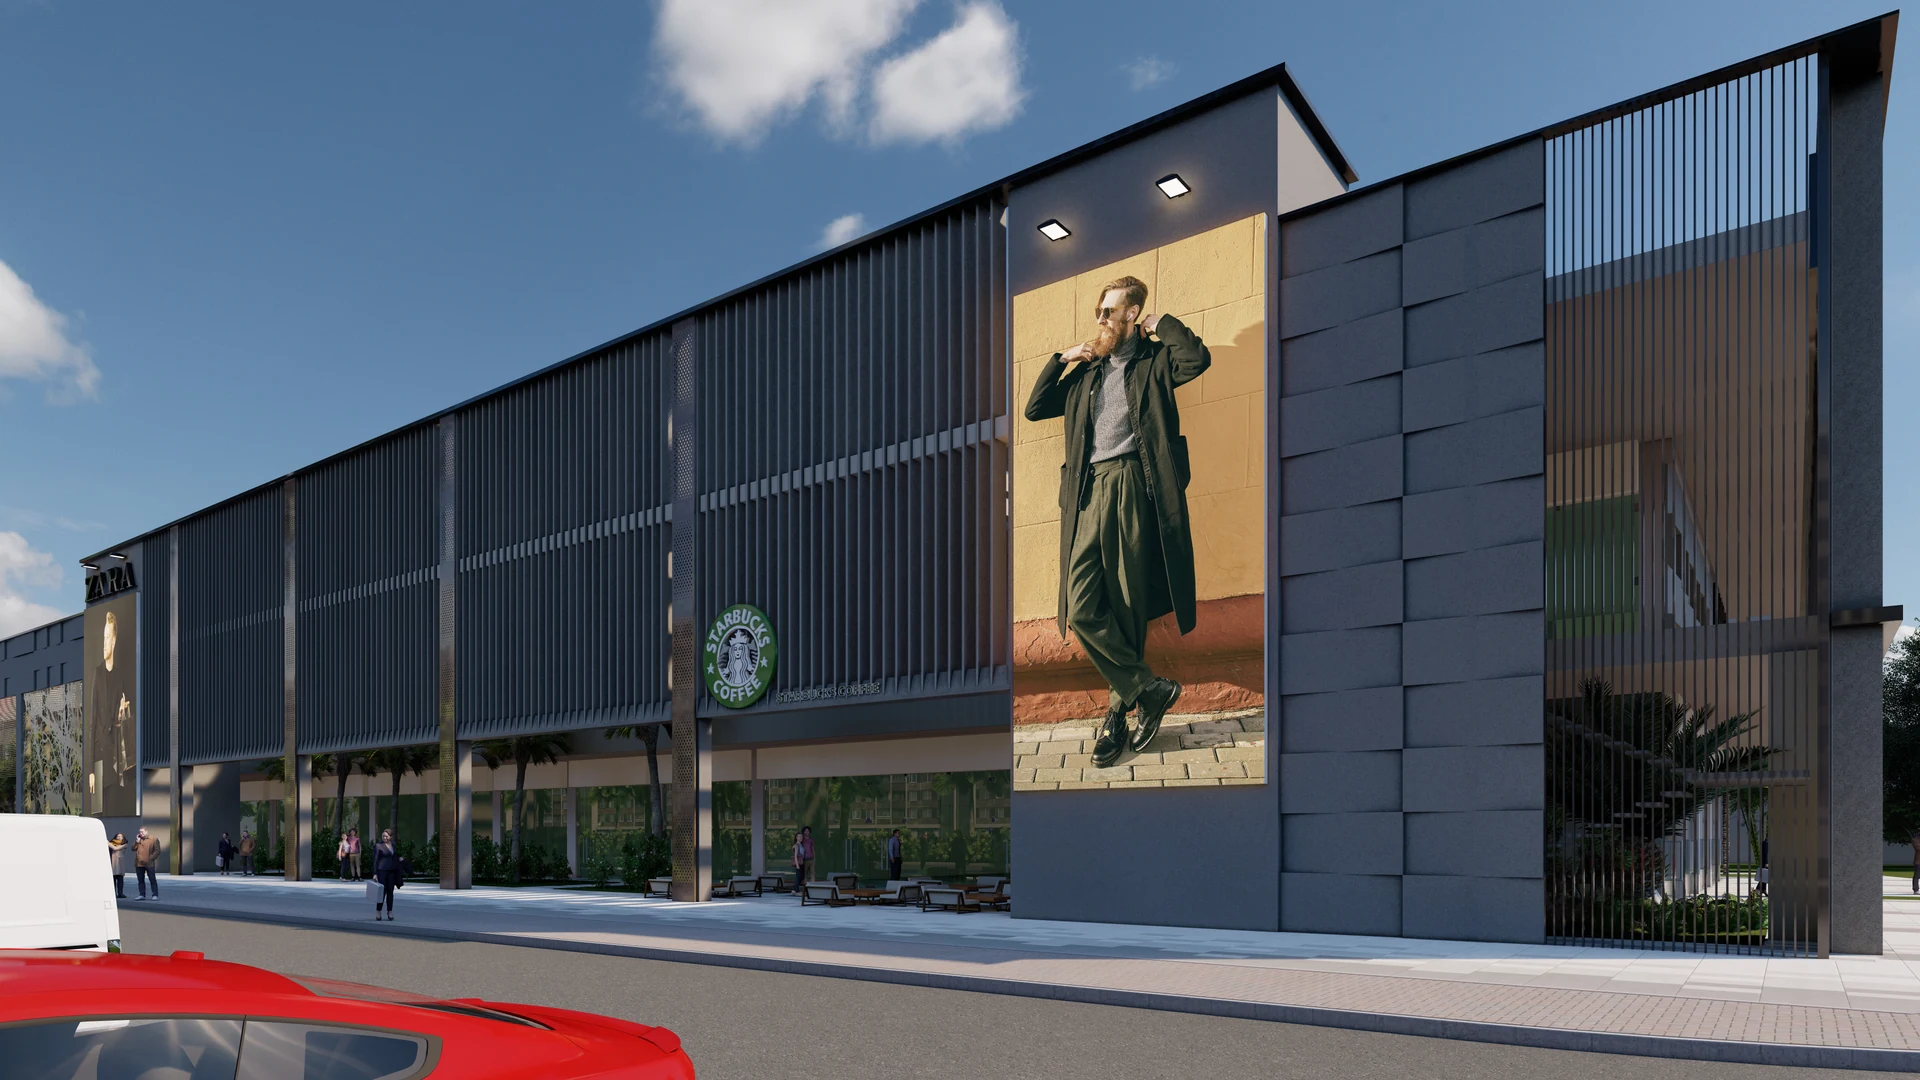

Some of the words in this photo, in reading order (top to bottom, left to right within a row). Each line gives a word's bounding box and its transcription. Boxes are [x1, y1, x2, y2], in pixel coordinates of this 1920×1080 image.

[85, 562, 135, 603] ZARA
[706, 608, 771, 654] STARBUCKS
[713, 674, 762, 702] COFFEE
[775, 686, 837, 704] STARBUCKS
[838, 682, 880, 697] COFFEE
